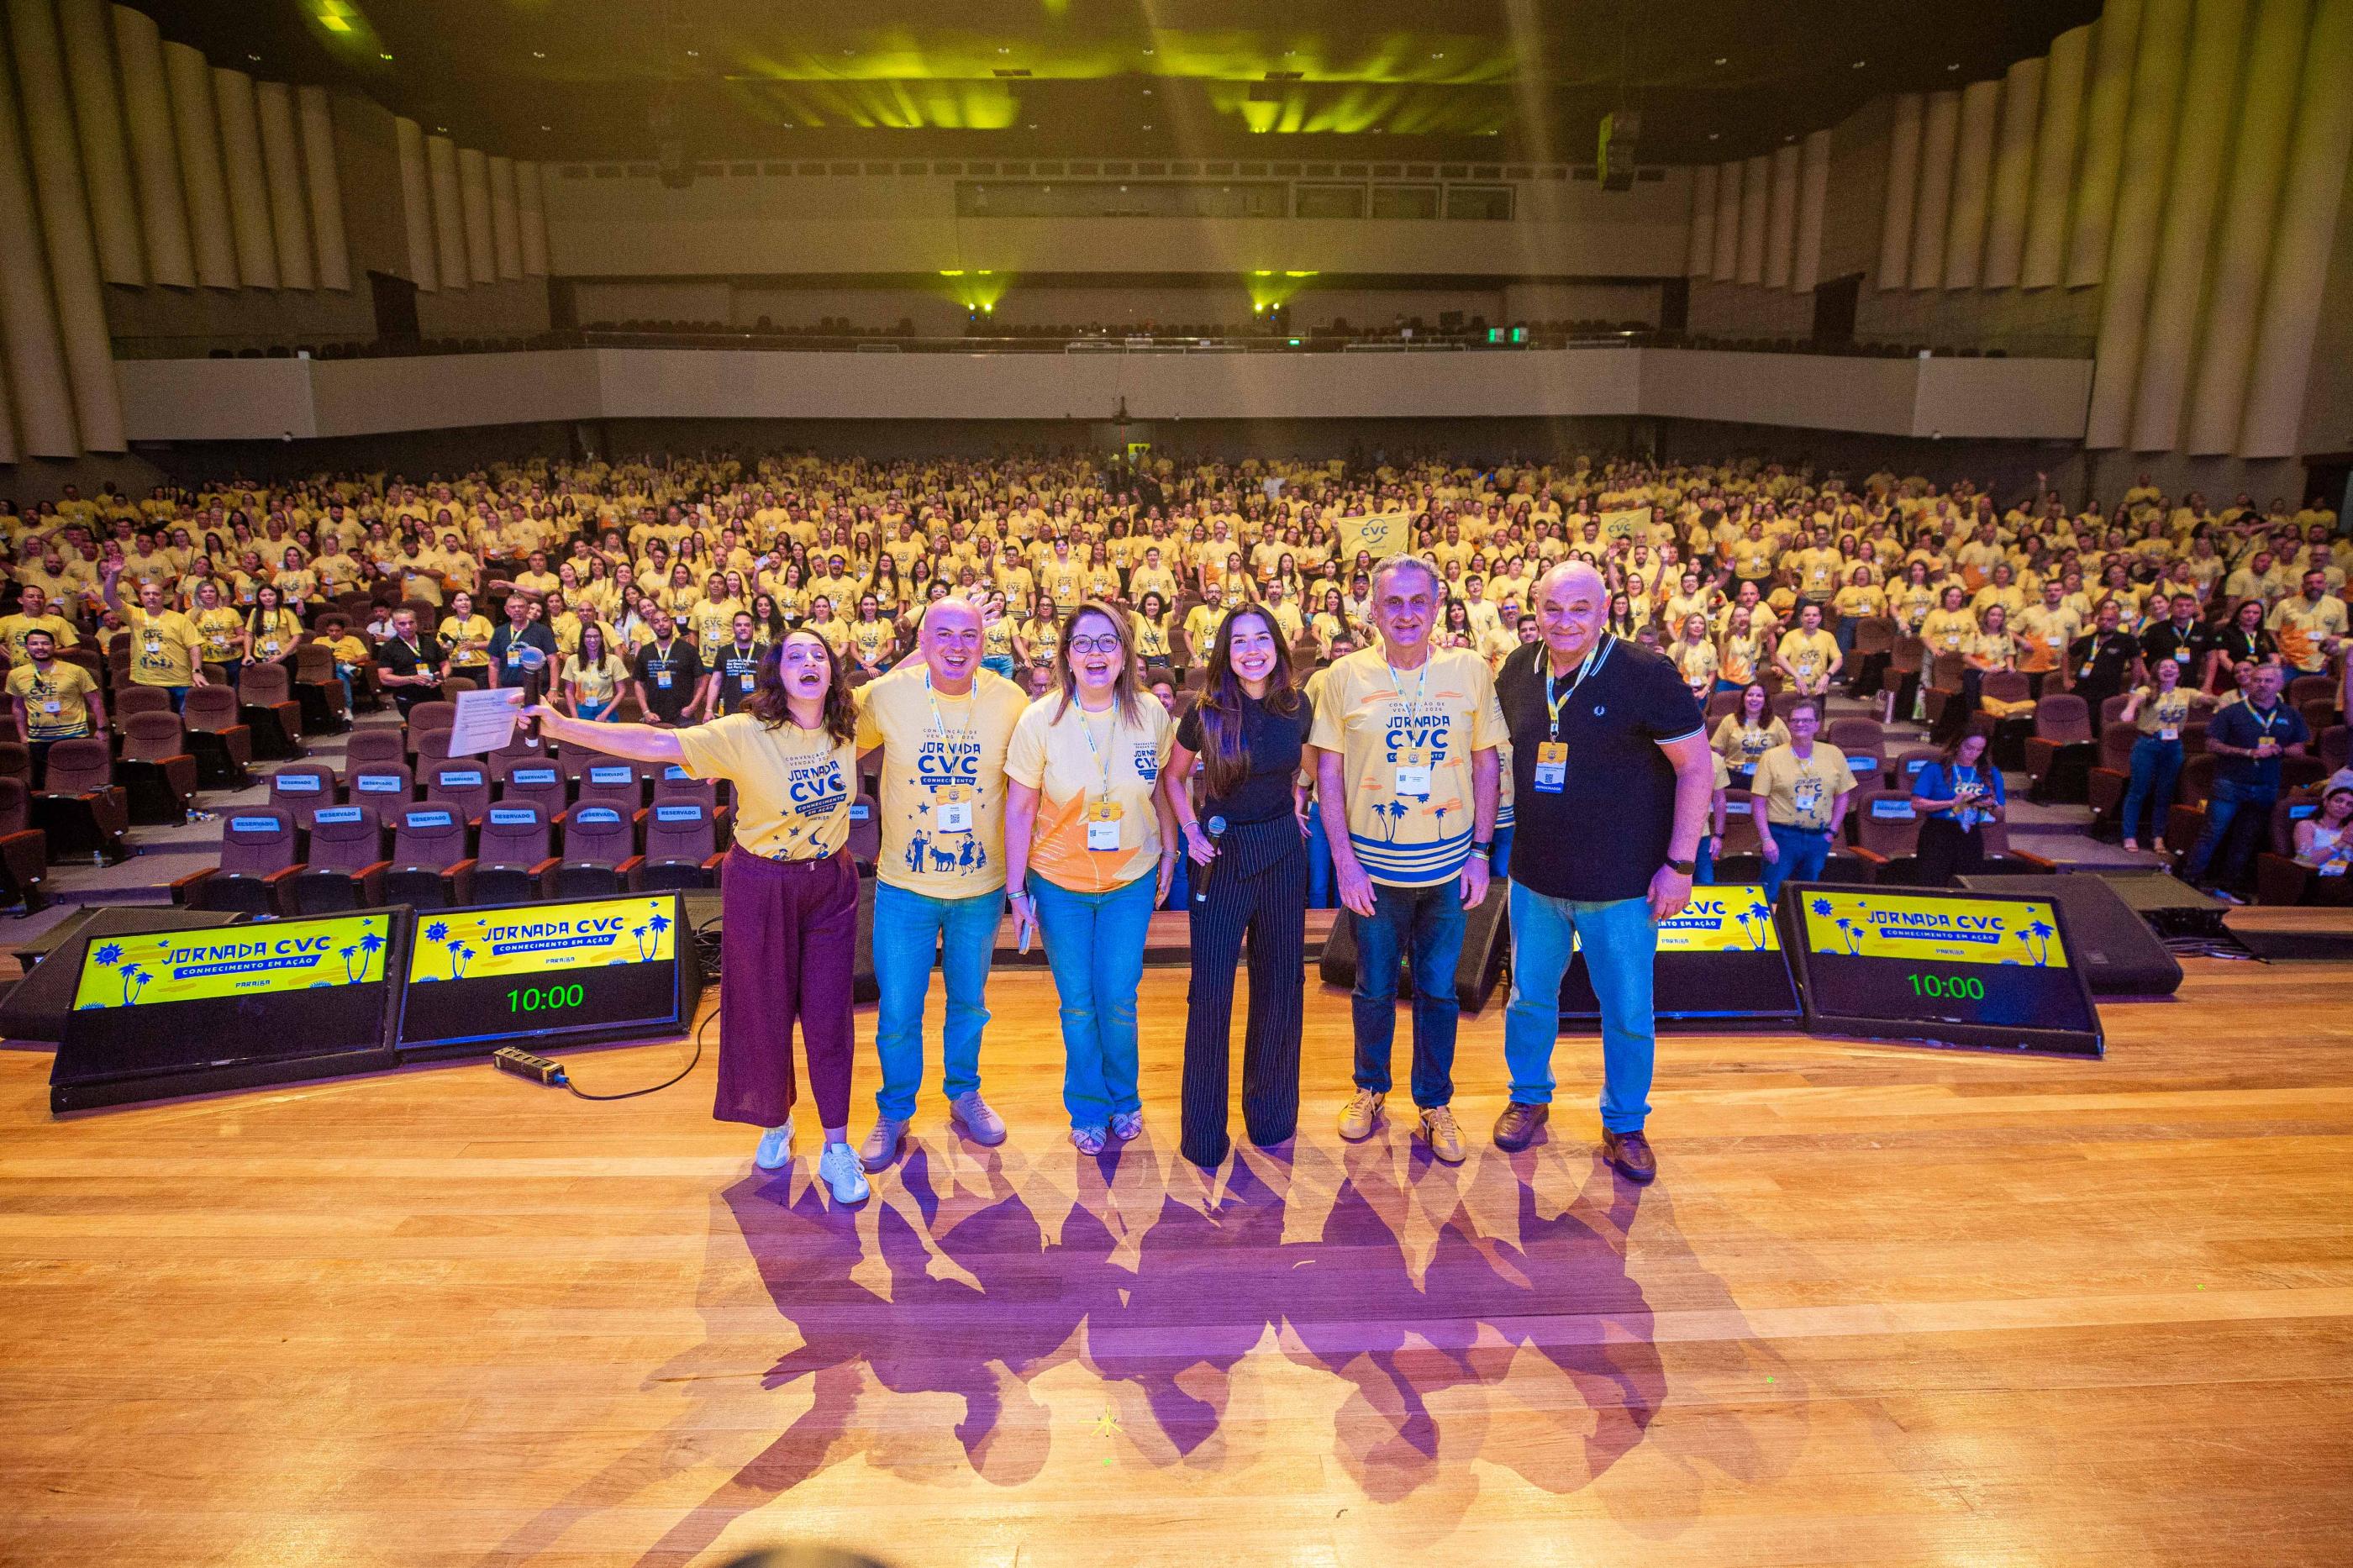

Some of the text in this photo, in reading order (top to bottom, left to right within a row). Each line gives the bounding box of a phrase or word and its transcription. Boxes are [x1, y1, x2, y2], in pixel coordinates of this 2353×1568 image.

[1361, 526, 1388, 536] CVC
[1608, 524, 1631, 532] CVC
[1386, 715, 1450, 729] JORNADA
[1385, 729, 1449, 750] CVC
[785, 751, 824, 761] CONVENÇÃO
[918, 755, 978, 775] CVC
[788, 760, 840, 781] JORNADA
[790, 773, 847, 802] CVC
[798, 796, 845, 812] CONHECIMENTO
[482, 917, 624, 942] JORNADA CVC
[1695, 919, 1716, 928] AÇÃO
[1867, 911, 2006, 931] JORNADA CVC
[1887, 929, 1953, 939] CONHECIMENTO
[161, 936, 331, 966] JORNADA CVC
[499, 941, 568, 952] CONHECIMENTO
[182, 962, 264, 976] CONHECIMENTO
[286, 957, 313, 966] AÇÃO
[235, 980, 271, 988] PARAÍBA
[1908, 973, 1985, 1000] 10:00
[506, 983, 584, 1013] 10:00
